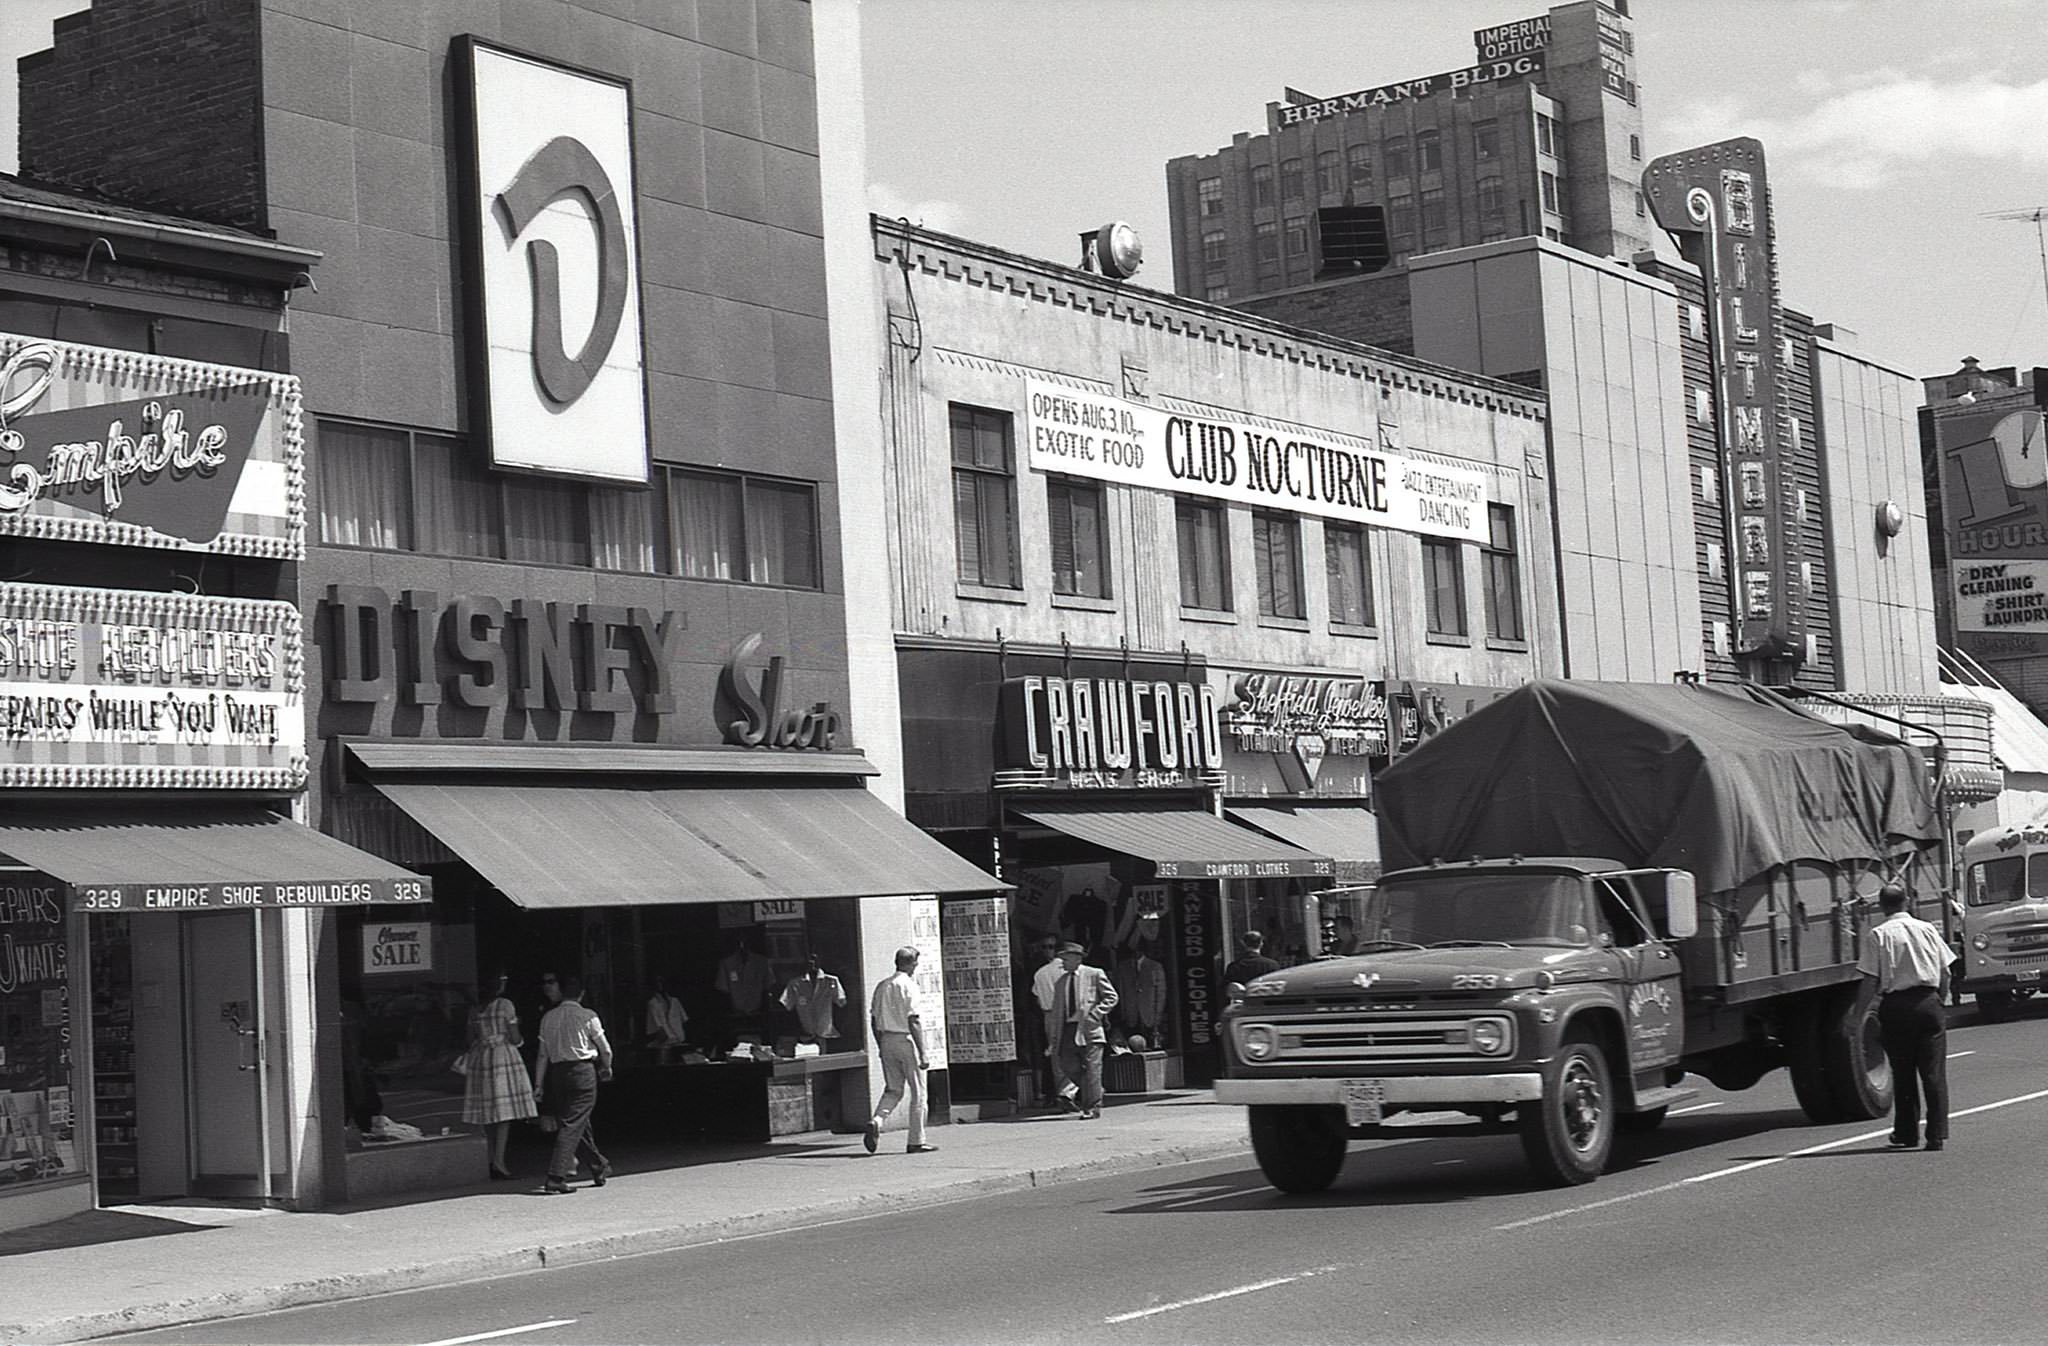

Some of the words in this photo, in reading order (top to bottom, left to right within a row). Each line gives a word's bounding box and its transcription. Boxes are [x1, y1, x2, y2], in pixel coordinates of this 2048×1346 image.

[1480, 16, 1552, 46] IMPERIAL
[1283, 78, 1432, 125] HERMANT
[1450, 57, 1541, 88] BLDG.
[1033, 393, 1079, 426] OPENS
[1719, 168, 1772, 620] BILTMORE
[1036, 426, 1095, 461] EXOTIC
[1103, 439, 1144, 469] FOOD
[1165, 415, 1237, 487] CLUB
[1247, 430, 1389, 514] NOCTURNE
[1419, 497, 1470, 530] DANCING
[1958, 522, 2048, 552] HOUR
[1960, 576, 2034, 597] CLEANING
[1969, 565, 2006, 581] DRY
[1995, 593, 2045, 611] SHIRT
[101, 624, 278, 677] REBUILDERS
[328, 583, 688, 714] DISNEY
[730, 632, 843, 750] Shop
[0, 695, 80, 738] PAIRS
[90, 694, 163, 740] WHILE
[171, 695, 217, 741] YOU
[226, 698, 278, 742] WAIT
[1239, 673, 1320, 728] Sheffield
[1320, 676, 1389, 731] Jewellers
[1023, 676, 1223, 769] CRAWFORD
[1206, 863, 1250, 877] CRAWFORD
[1256, 862, 1290, 876] CLOTHES
[1314, 862, 1330, 875] 325
[86, 889, 121, 909] 329
[145, 886, 209, 908] EMPIRE
[222, 885, 264, 905] SHOE
[275, 883, 372, 904] REBUILDERS
[394, 882, 422, 901] 329
[760, 899, 798, 916] SALE
[1182, 881, 1206, 958] RAWFORD
[17, 943, 55, 985] WAIT
[371, 943, 421, 967] SALE
[1248, 980, 1287, 996] 253
[1452, 973, 1499, 990] 253
[1186, 966, 1211, 1044] CLOTHES
